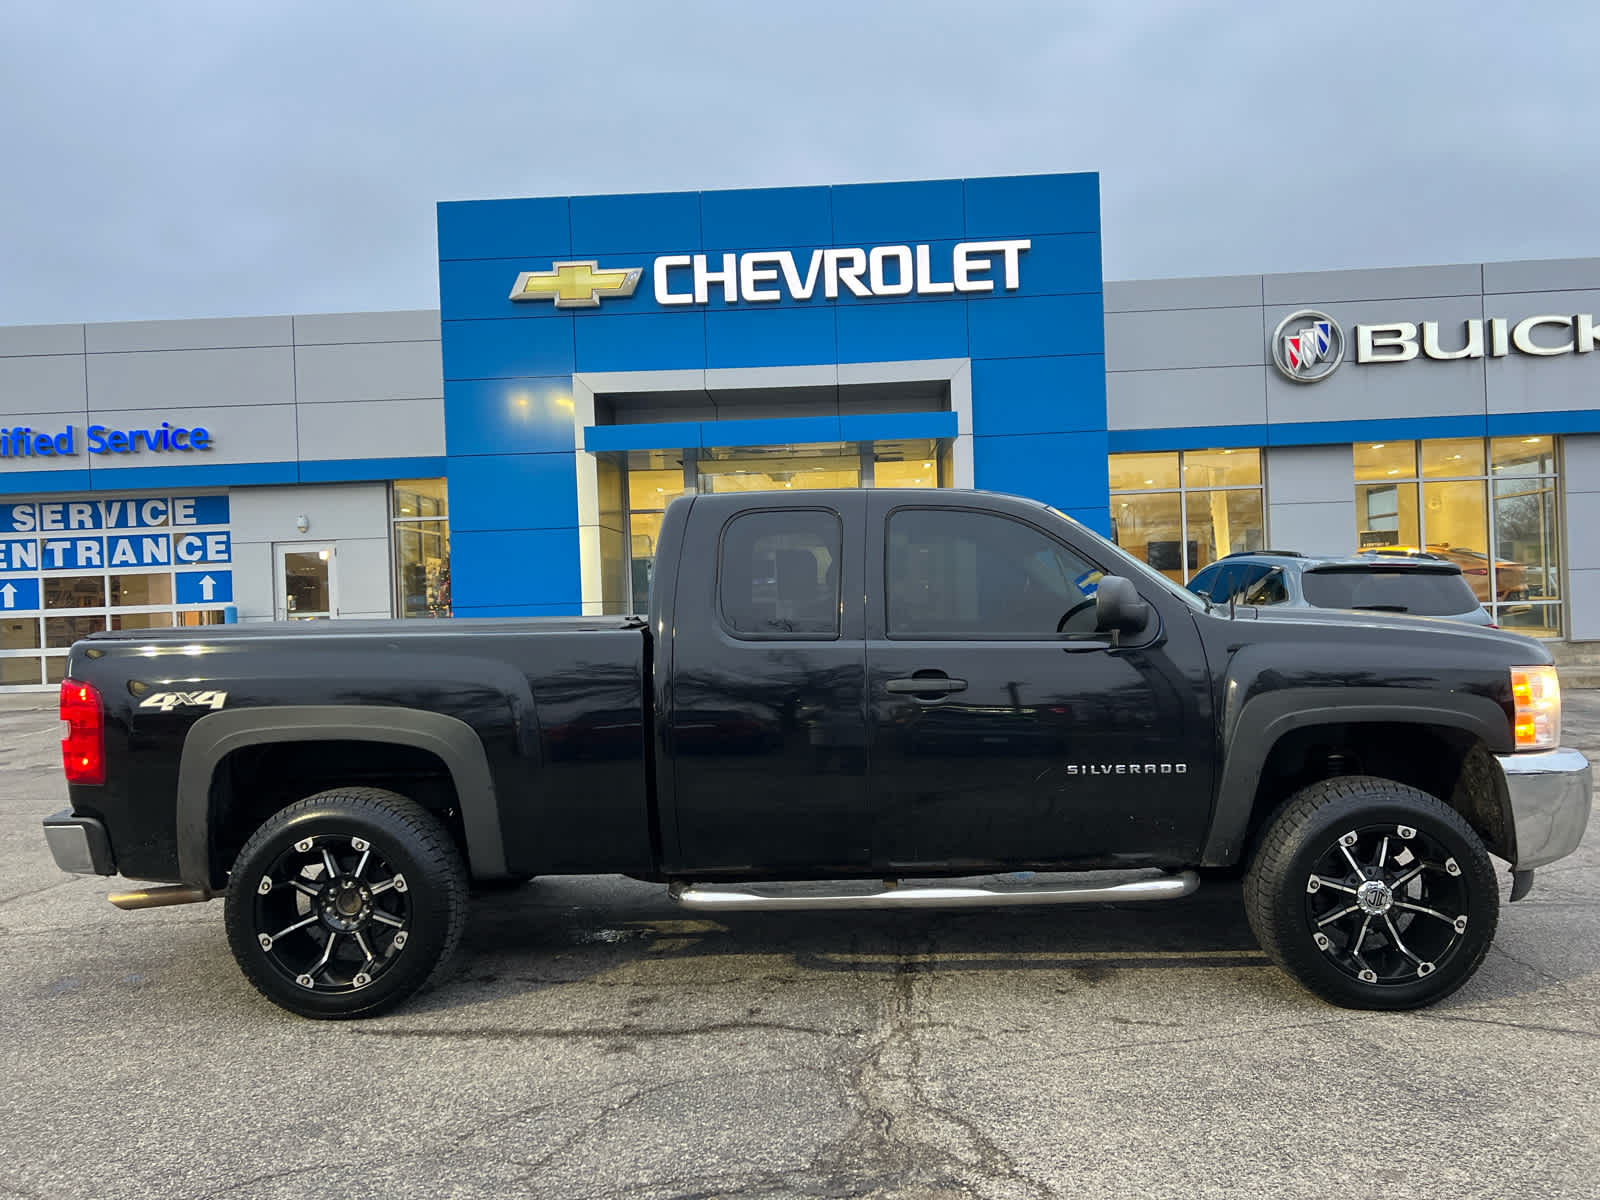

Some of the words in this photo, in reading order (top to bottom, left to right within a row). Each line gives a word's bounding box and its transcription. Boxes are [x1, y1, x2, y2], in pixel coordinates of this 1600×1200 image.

[653, 239, 1031, 305] CHEVROLET
[0, 425, 74, 457] ified
[86, 422, 210, 454] Service
[12, 499, 198, 532] SERVICE
[1066, 764, 1188, 775] SILVERADO
